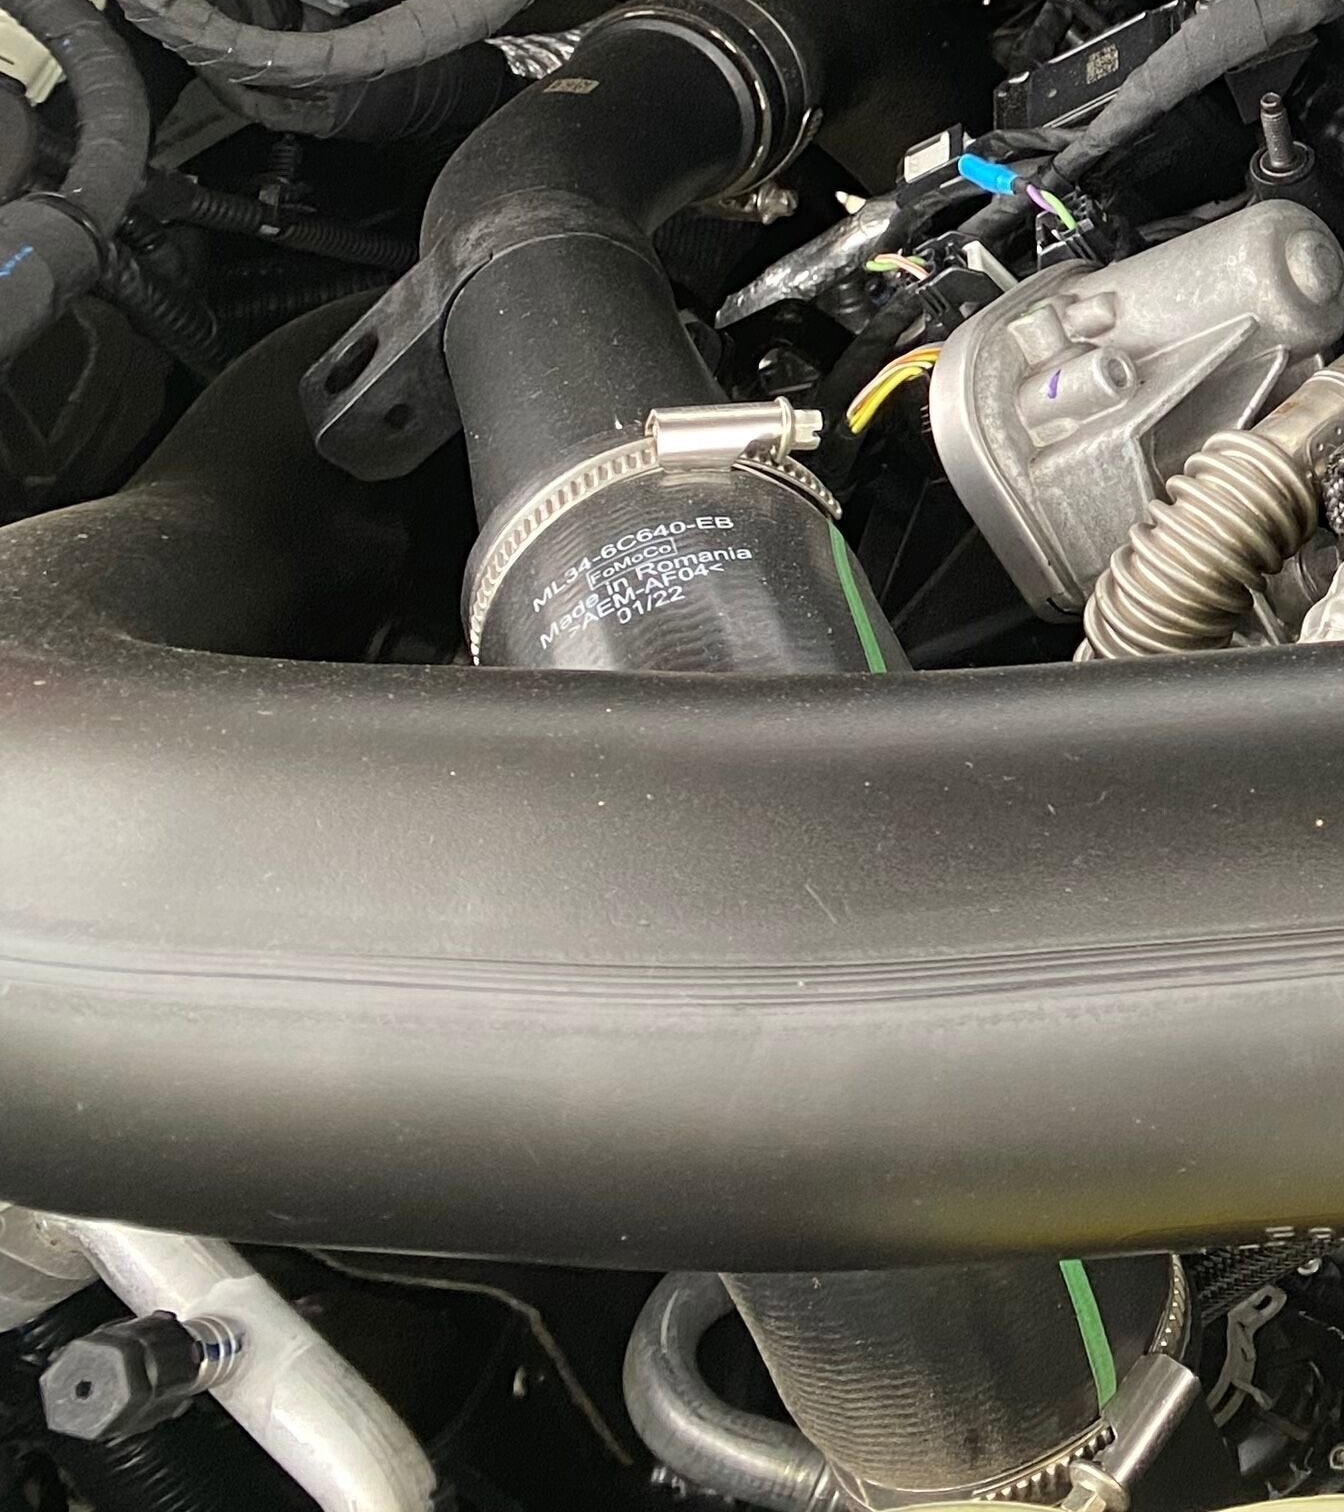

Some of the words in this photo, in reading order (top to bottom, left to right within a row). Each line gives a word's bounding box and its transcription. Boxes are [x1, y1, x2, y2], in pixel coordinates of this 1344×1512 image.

[533, 516, 734, 613] ML34-6C640-EB
[539, 593, 601, 649] Made
[606, 578, 629, 595] in
[636, 547, 753, 581] Romania
[590, 544, 672, 586] FoMoCo
[617, 586, 686, 625] 01/22
